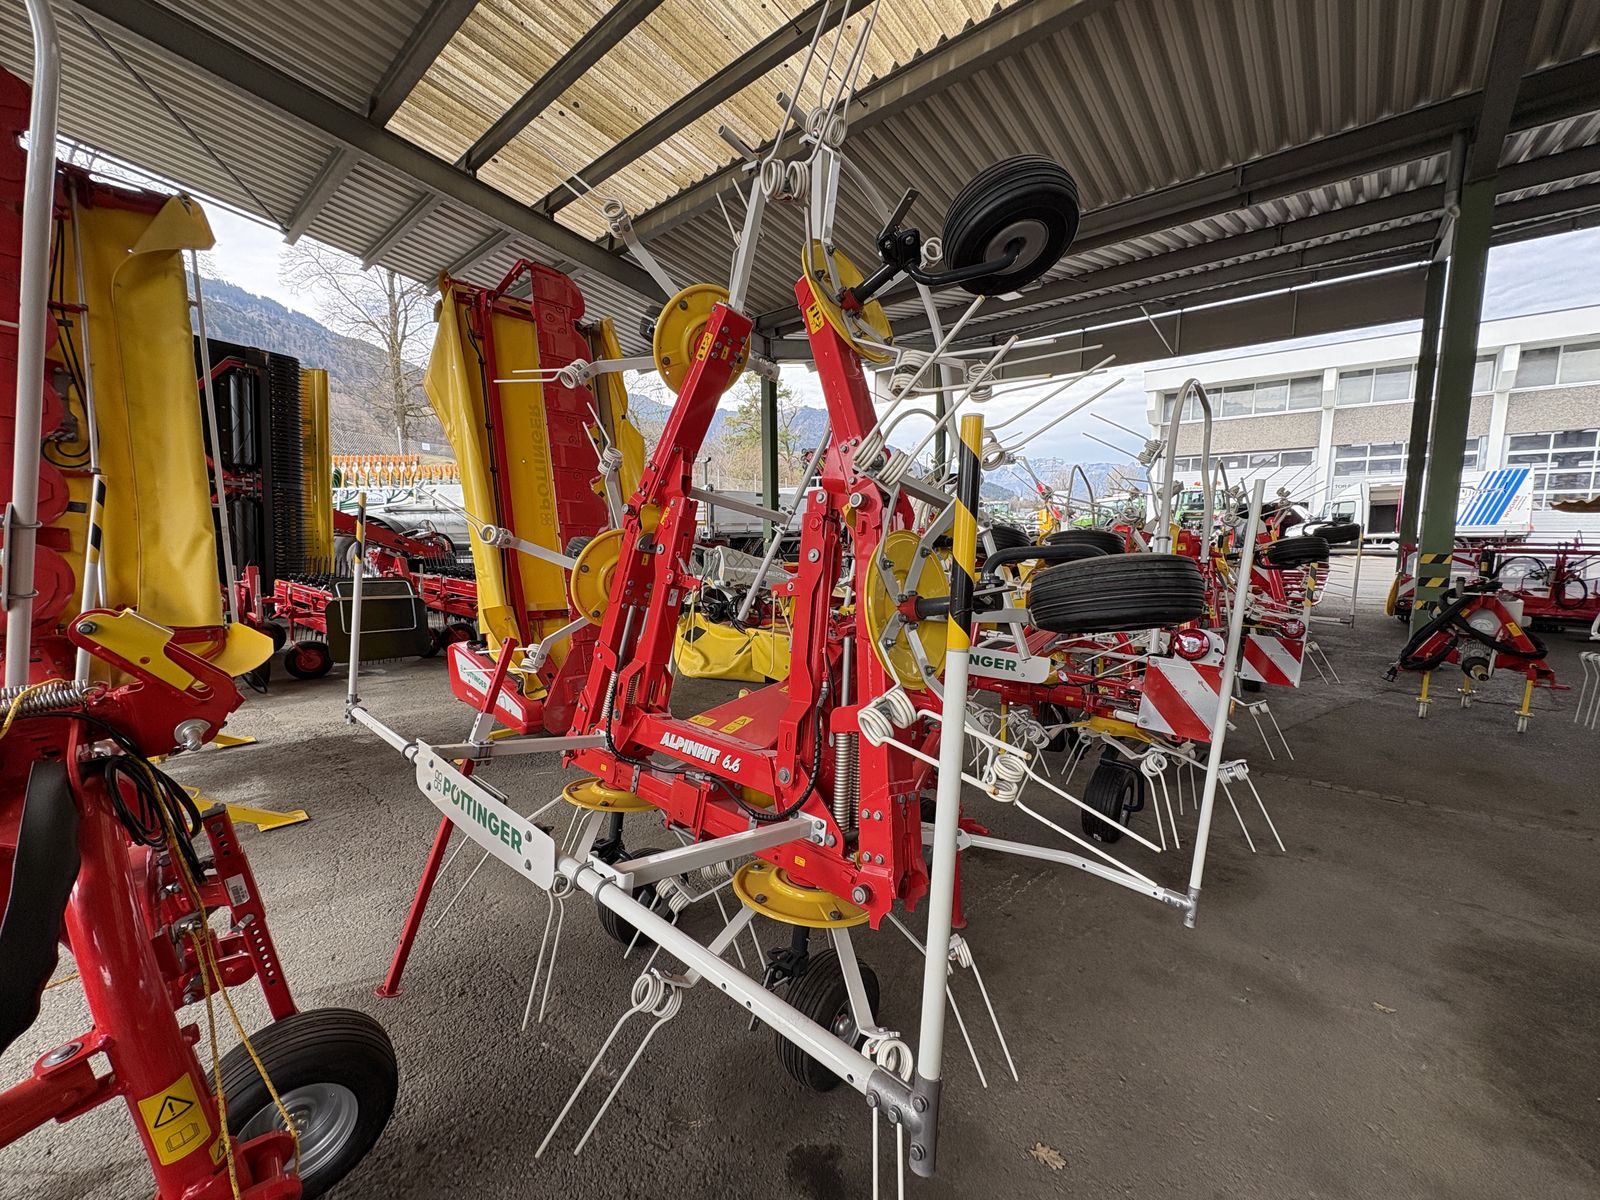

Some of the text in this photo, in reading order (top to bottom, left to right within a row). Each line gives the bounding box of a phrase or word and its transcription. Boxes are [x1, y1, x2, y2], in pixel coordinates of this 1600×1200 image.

[969, 653, 1017, 672] NGER
[660, 731, 741, 772] ALPINHIT 6.6
[442, 776, 522, 855] PÖTTINGER
